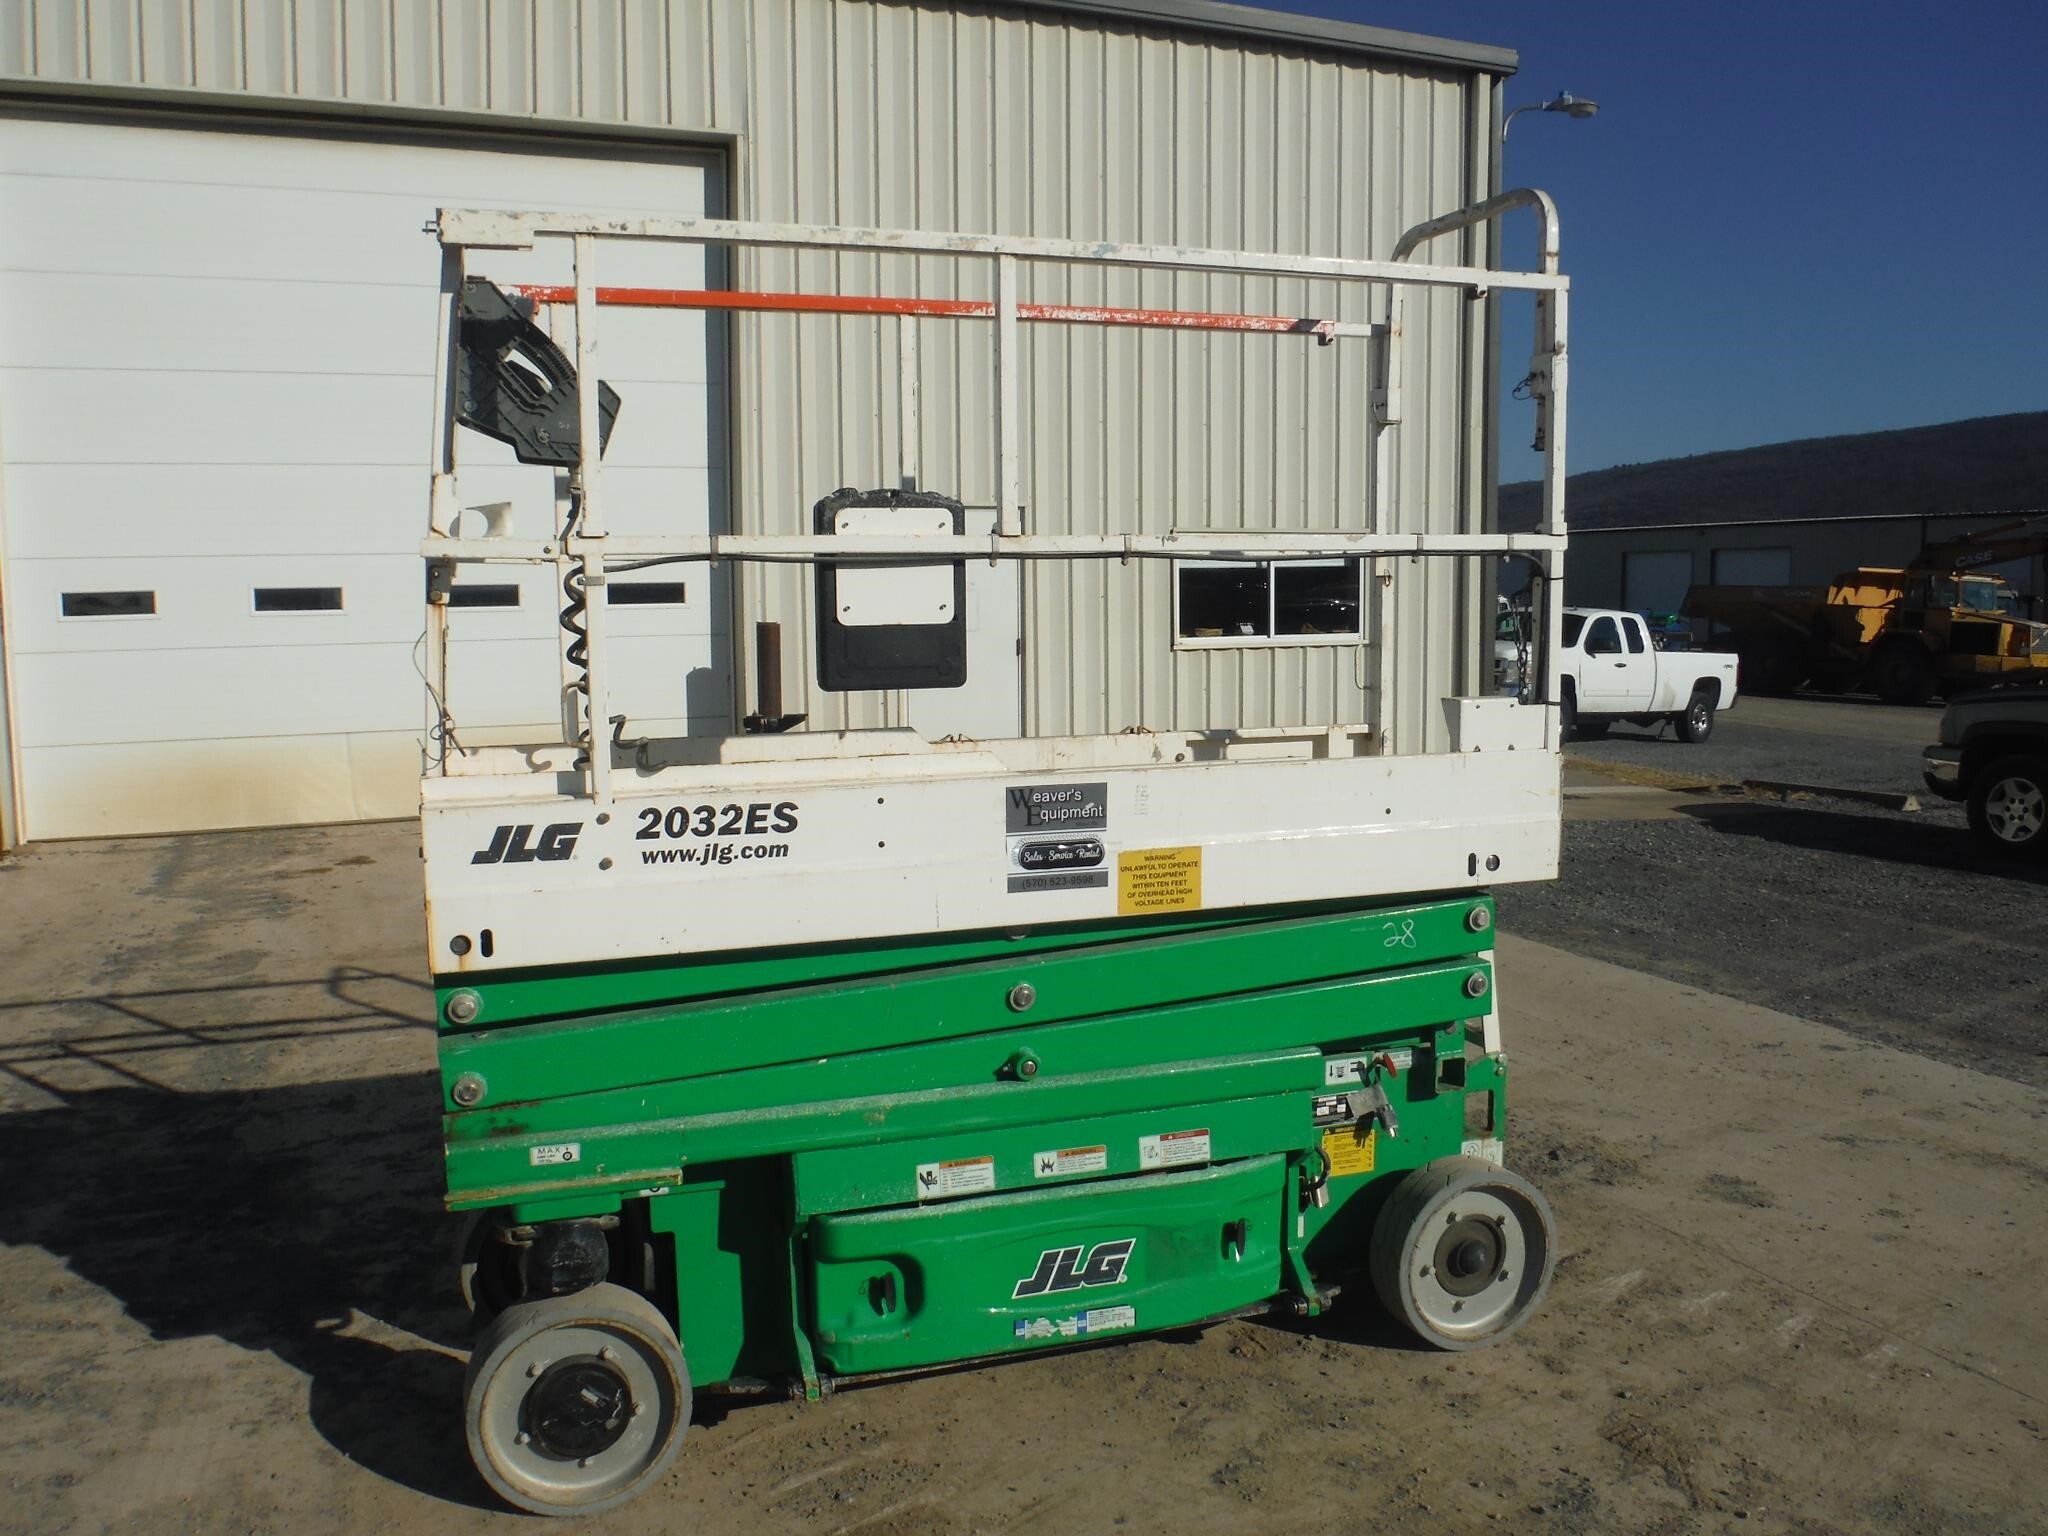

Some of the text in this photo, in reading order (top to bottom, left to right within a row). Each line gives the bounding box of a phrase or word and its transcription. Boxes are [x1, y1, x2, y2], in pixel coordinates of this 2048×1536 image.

[1955, 551, 1992, 567] CASE
[1009, 788, 1082, 808] Weaver's
[636, 801, 799, 840] 2032ES
[1025, 804, 1103, 826] Equipment
[471, 823, 583, 864] JLG
[642, 843, 789, 866] www.jlg.com
[1023, 847, 1099, 862] Sales Service Rental
[1144, 853, 1176, 861] WARNING
[1120, 863, 1157, 872] UNLAWFUL
[1168, 861, 1199, 869] OPERATE
[1149, 871, 1187, 879] EQUIPMENT
[1022, 877, 1047, 889] (570)
[1132, 881, 1155, 889] WITHIN
[1138, 889, 1175, 897] OVERHEAD
[1383, 919, 1417, 948] 28
[537, 1146, 560, 1154] MAX
[1012, 1238, 1136, 1299] JLG
